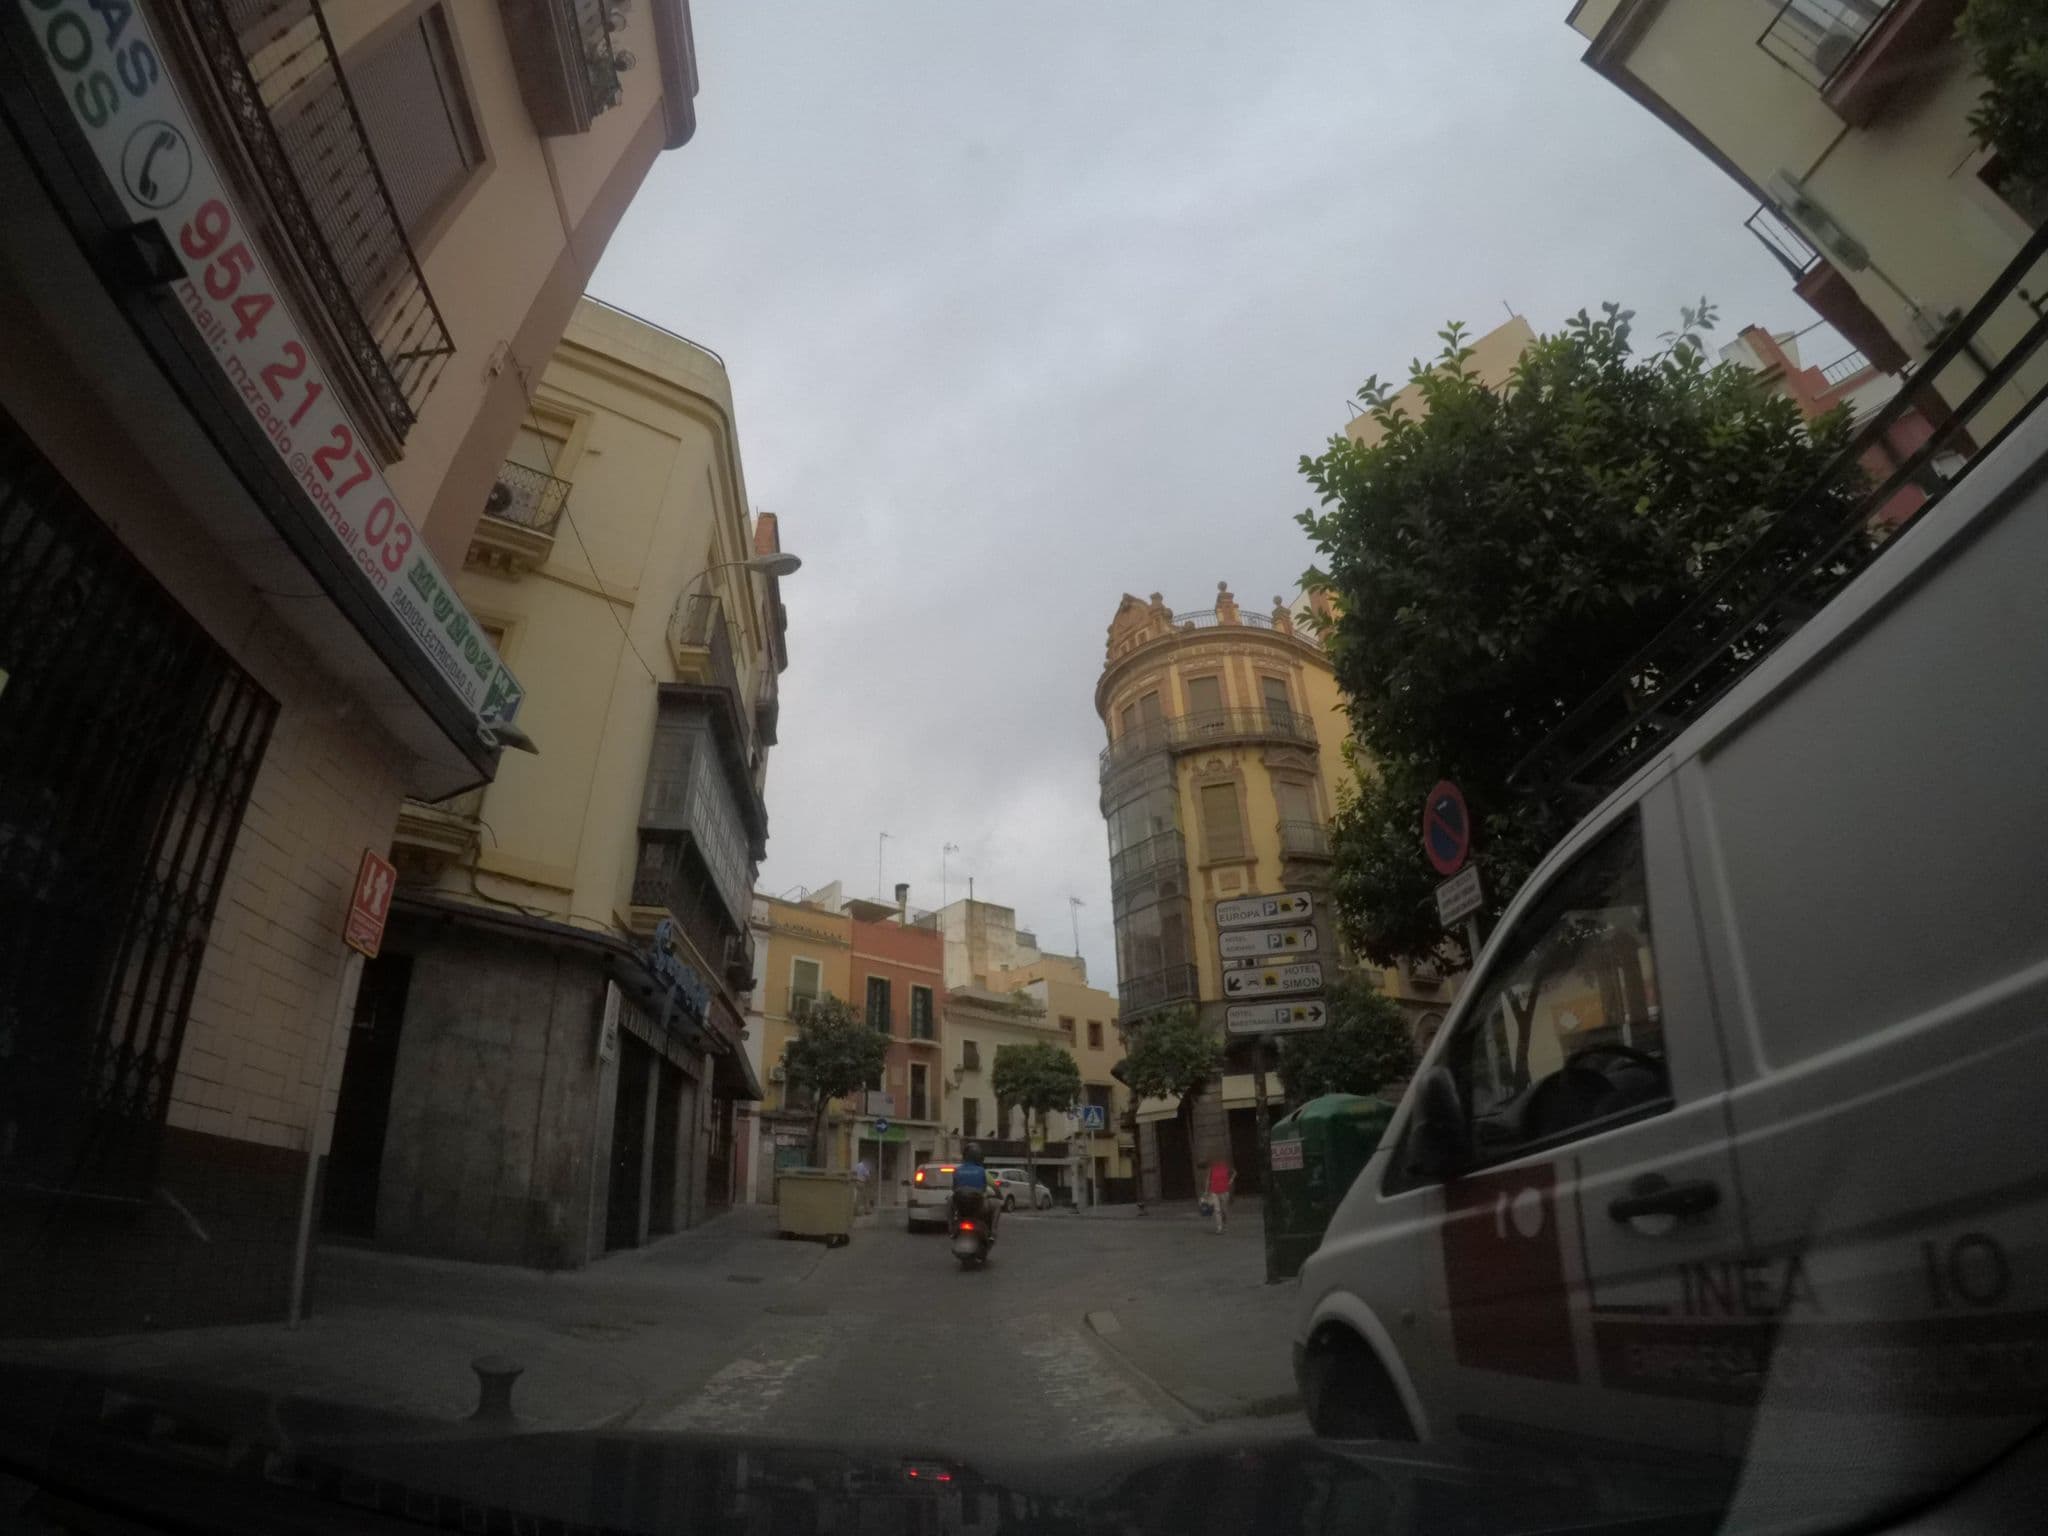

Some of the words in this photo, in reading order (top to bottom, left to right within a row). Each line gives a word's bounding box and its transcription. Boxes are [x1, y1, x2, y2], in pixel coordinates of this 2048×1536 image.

[180, 200, 275, 342] 954
[261, 340, 323, 427] 21
[313, 424, 373, 499] 27
[364, 497, 413, 573] 03
[1219, 911, 1260, 923] EUROPA
[1284, 965, 1315, 975] HOTEL
[1282, 977, 1320, 988] SIMON
